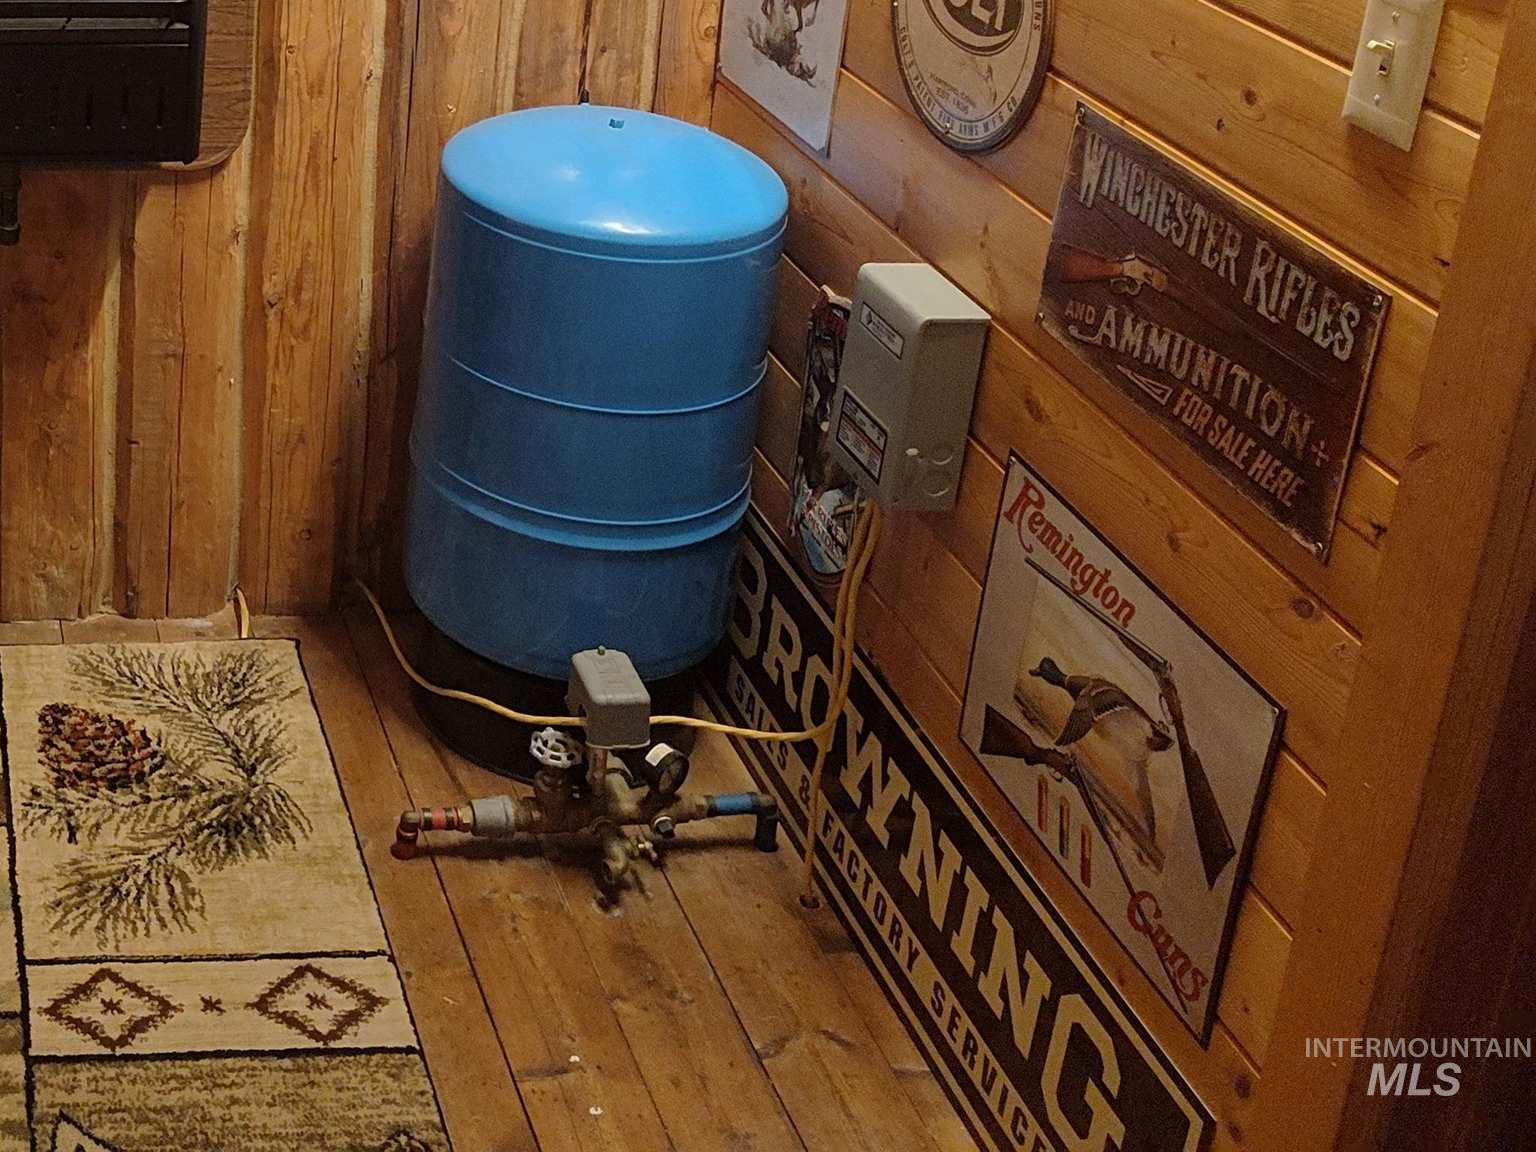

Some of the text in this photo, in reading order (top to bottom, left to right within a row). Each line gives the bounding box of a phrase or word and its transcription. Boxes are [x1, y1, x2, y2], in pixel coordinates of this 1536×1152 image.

[1078, 131, 1362, 363] WINCHESTER RIFLES
[1064, 300, 1316, 457] AND AMMUNITION
[1173, 386, 1306, 509] FOR SALE HERE
[1003, 475, 1138, 629] Remington
[728, 542, 1128, 1152] BROWNING
[822, 809, 921, 974] FACTORY
[931, 980, 1046, 1152] SERVIC
[1126, 888, 1210, 1003] Guns
